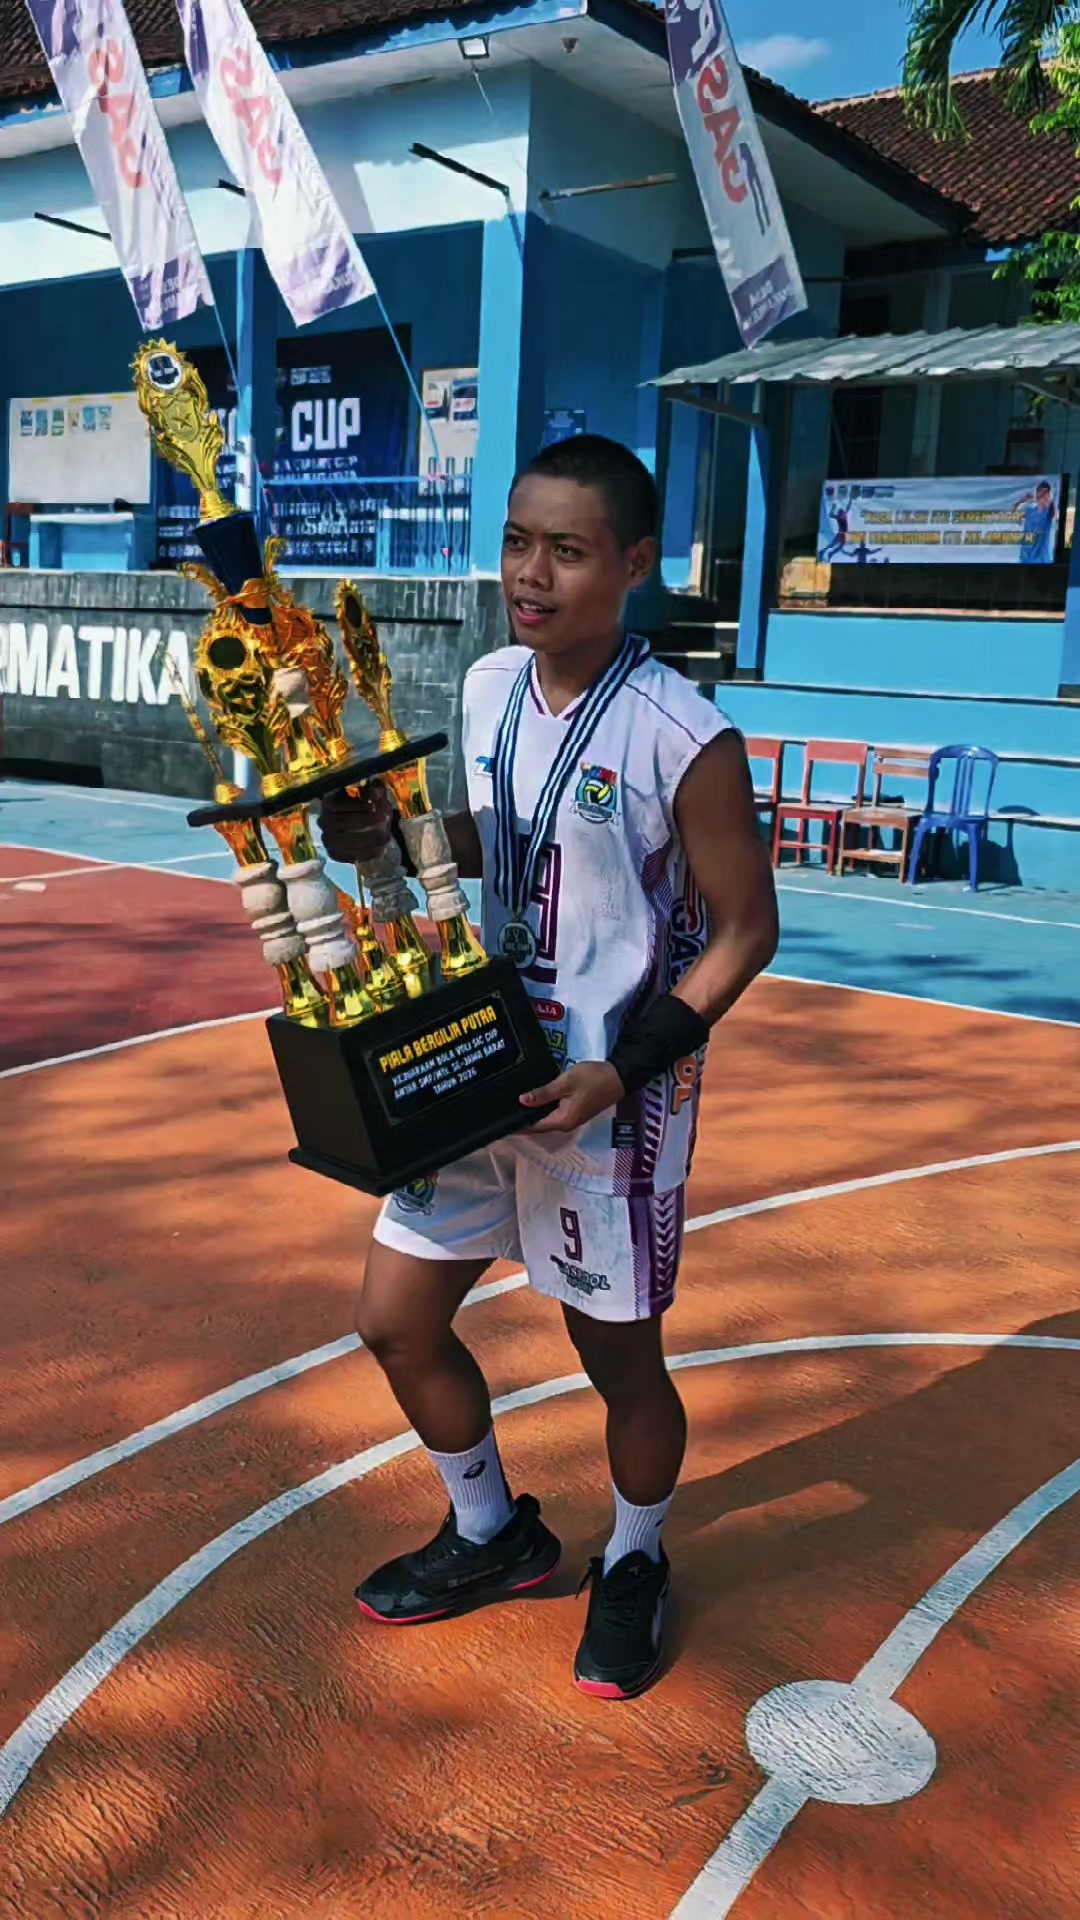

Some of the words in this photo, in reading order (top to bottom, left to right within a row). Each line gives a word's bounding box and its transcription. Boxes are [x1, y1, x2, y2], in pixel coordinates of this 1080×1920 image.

[291, 397, 361, 453] CUP
[379, 1044, 414, 1073] PIALA
[460, 1005, 497, 1035] PUTRA
[559, 1206, 583, 1265] 9
